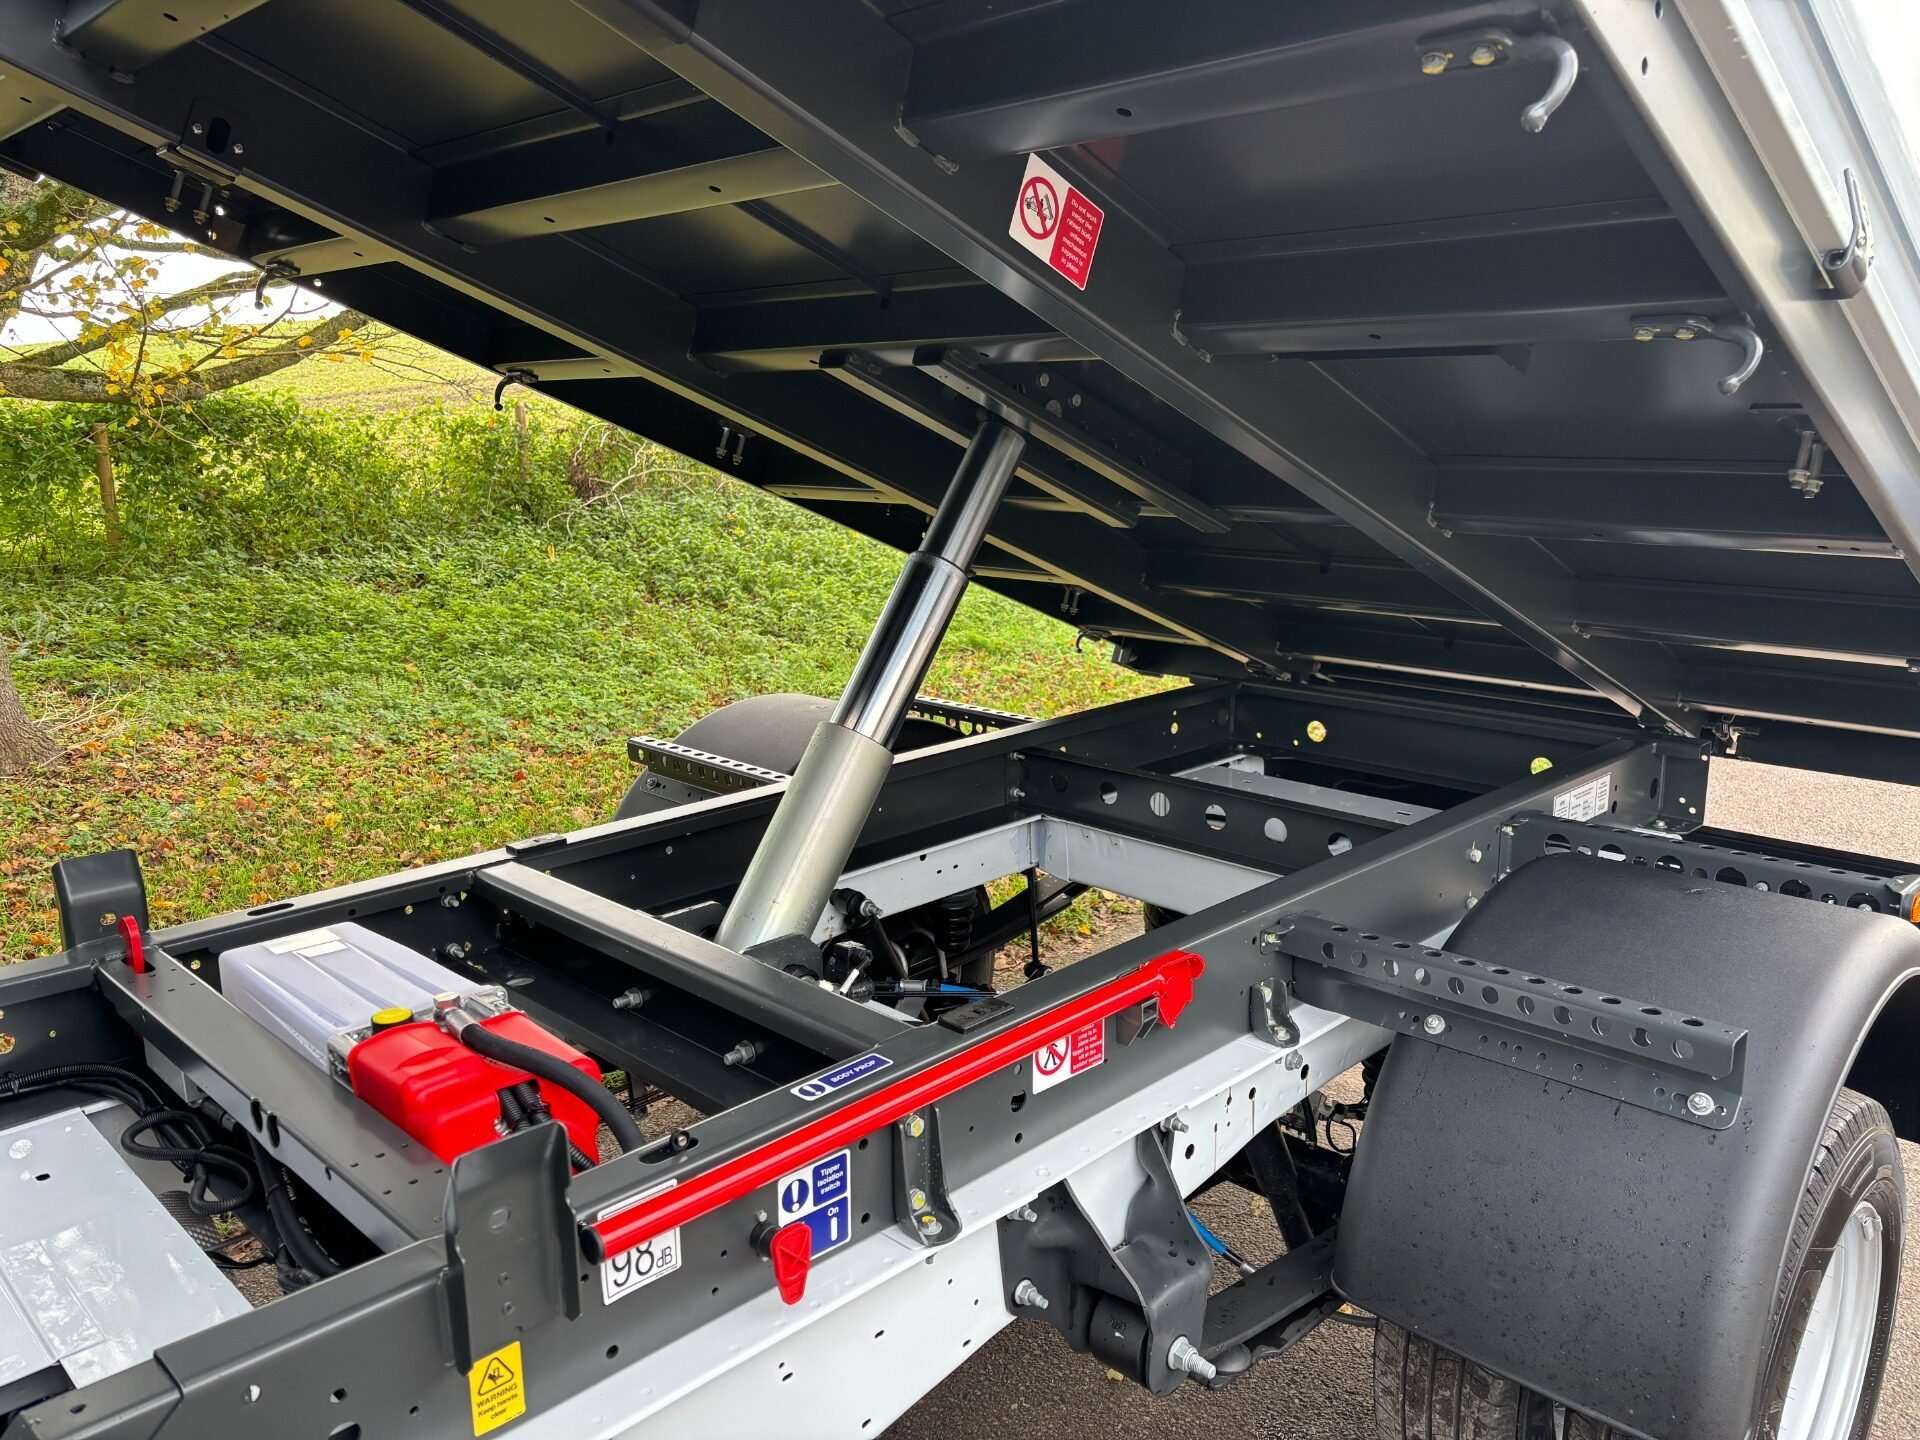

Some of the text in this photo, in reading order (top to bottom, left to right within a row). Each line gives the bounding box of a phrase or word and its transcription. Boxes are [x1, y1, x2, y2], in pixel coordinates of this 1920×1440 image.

[1071, 211, 1085, 225] under
[1086, 211, 1097, 224] work
[1067, 218, 1093, 243] raised body
[1061, 246, 1080, 264] support
[830, 1059, 876, 1083] BODY PROP
[820, 1163, 841, 1177] Tipper
[820, 1180, 841, 1195] switch
[827, 1206, 839, 1217] On
[656, 1246, 673, 1269] dB
[476, 1382, 518, 1408] WARNING
[478, 1404, 497, 1418] Keep
[497, 1393, 519, 1407] hands
[490, 1407, 507, 1420] clear
